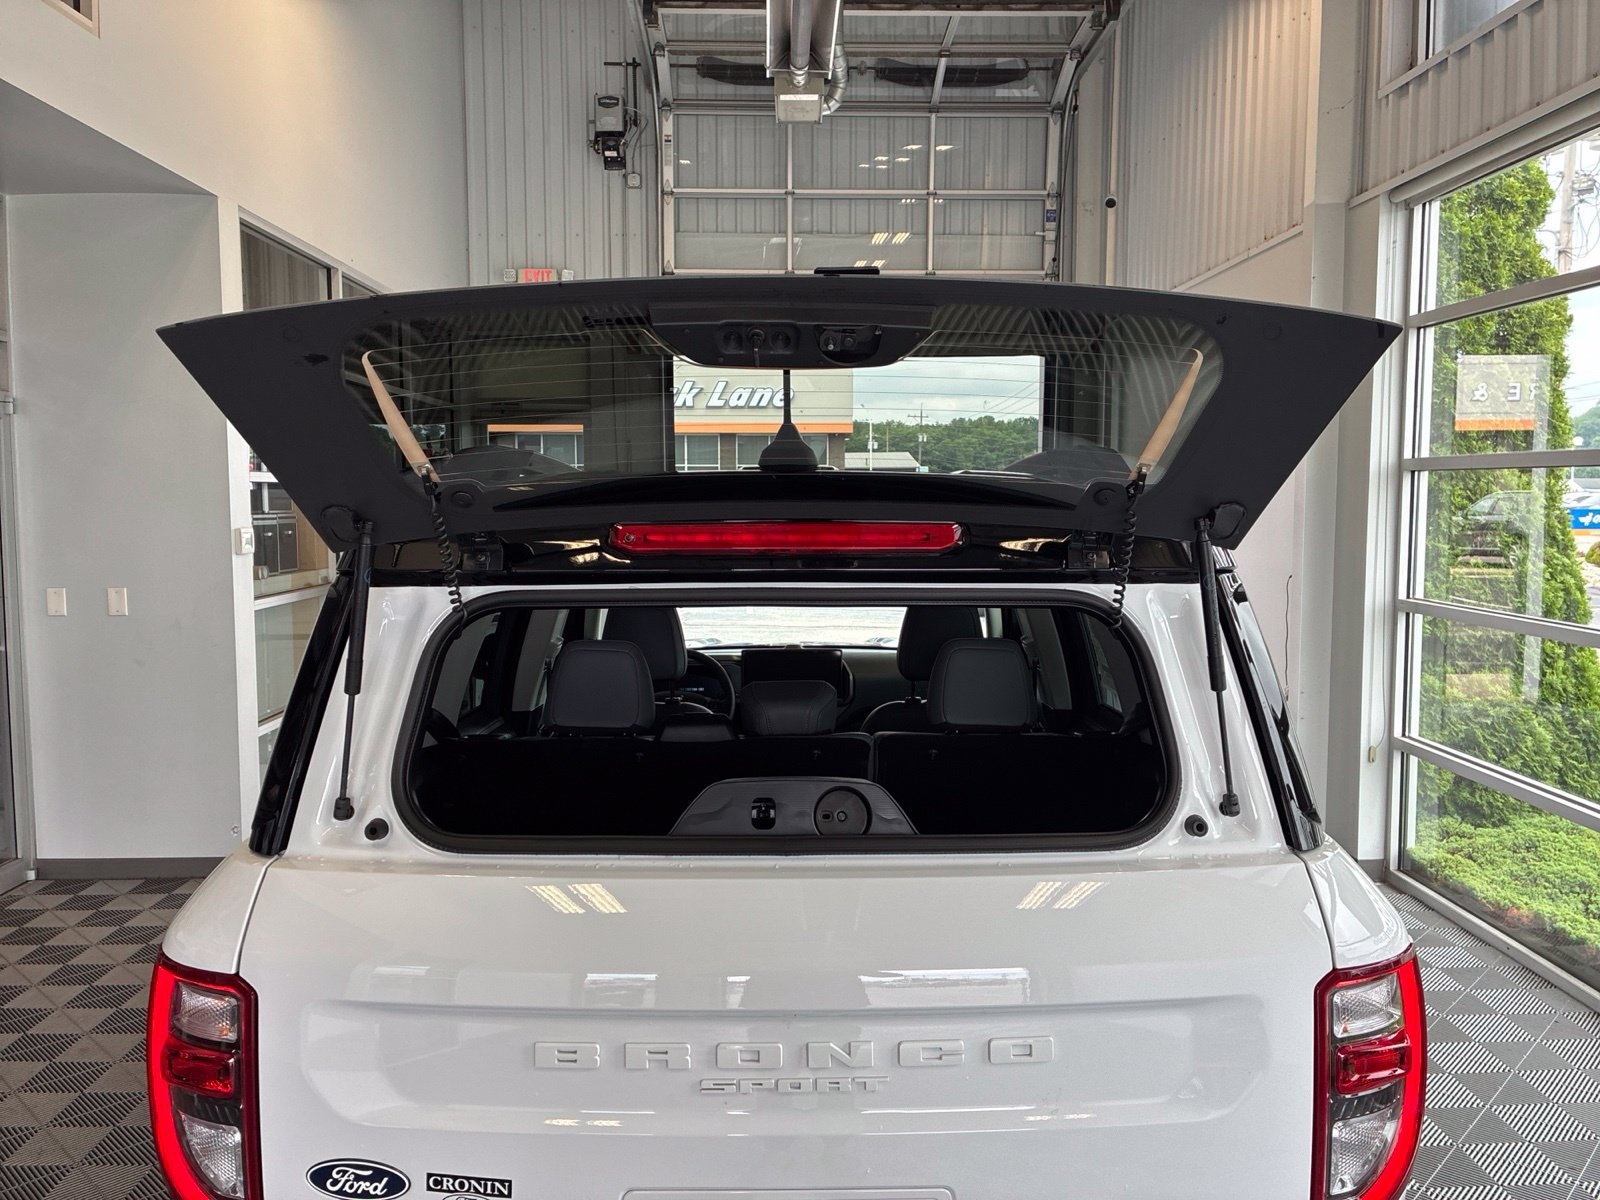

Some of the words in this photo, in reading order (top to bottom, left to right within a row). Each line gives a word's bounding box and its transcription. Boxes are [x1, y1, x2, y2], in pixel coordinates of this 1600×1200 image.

[524, 267, 552, 282] EXIT
[706, 380, 794, 408] Lane
[534, 1036, 1055, 1070] BRONCO
[700, 1075, 890, 1094] SPORT
[326, 1166, 389, 1195] Ford
[428, 1176, 510, 1196] CRONIN
